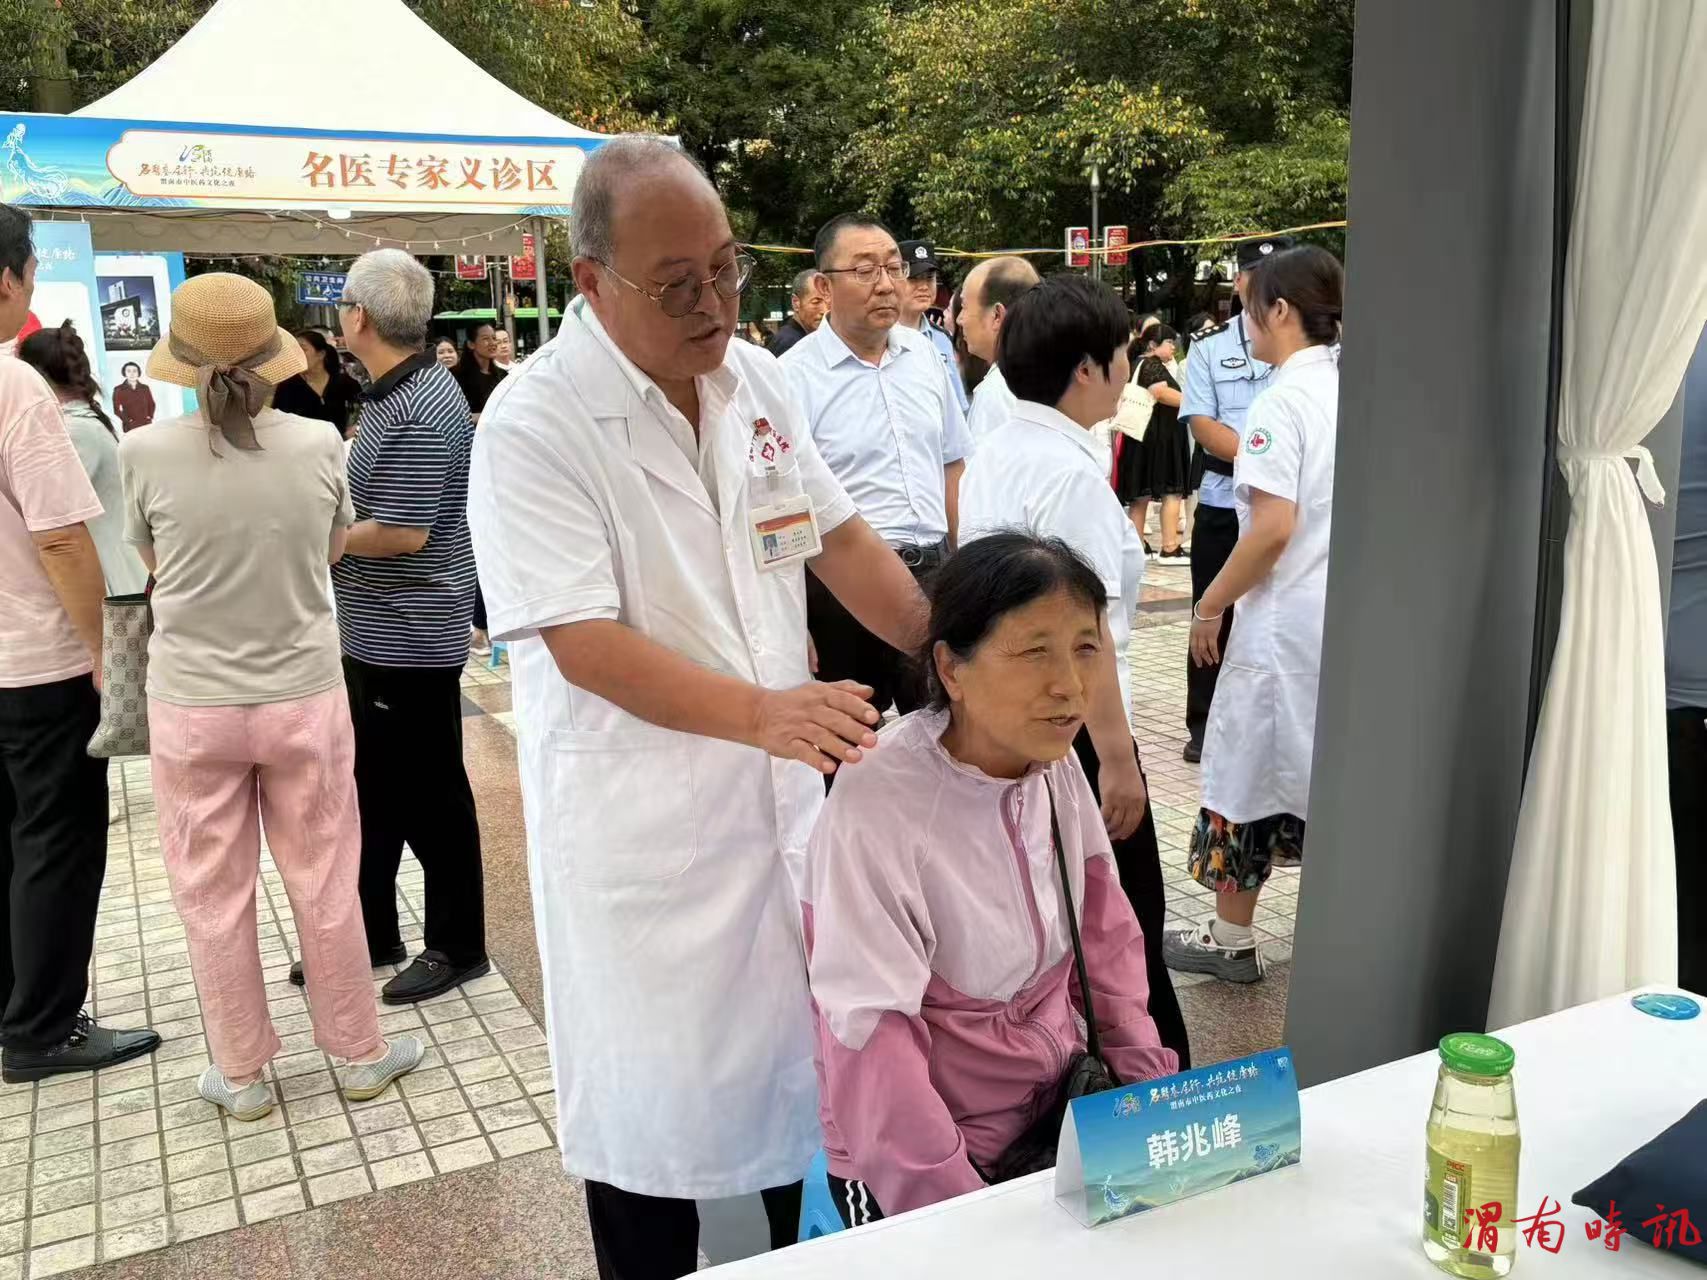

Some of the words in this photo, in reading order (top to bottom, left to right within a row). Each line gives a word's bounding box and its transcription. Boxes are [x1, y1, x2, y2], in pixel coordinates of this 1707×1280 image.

[300, 150, 559, 191] 名医专家义诊区
[1146, 1112, 1242, 1169] 韩兆峰
